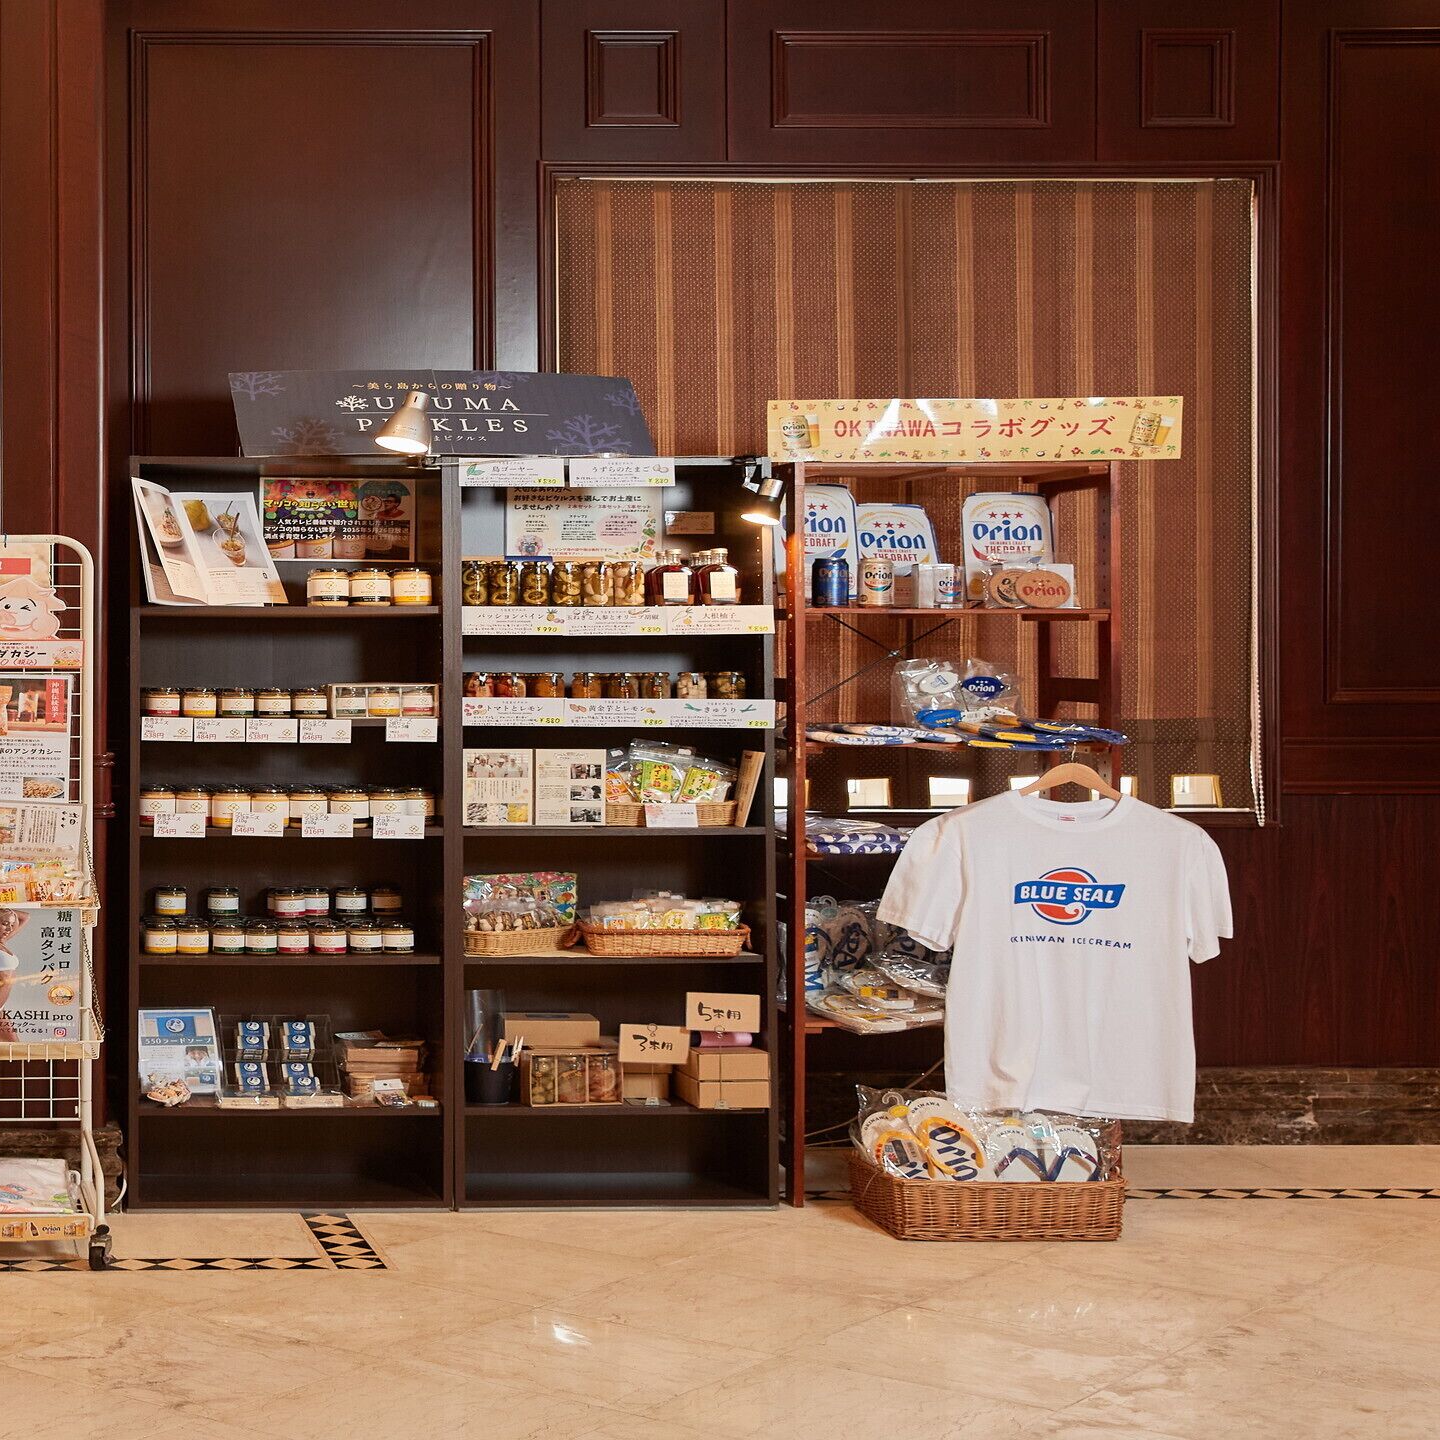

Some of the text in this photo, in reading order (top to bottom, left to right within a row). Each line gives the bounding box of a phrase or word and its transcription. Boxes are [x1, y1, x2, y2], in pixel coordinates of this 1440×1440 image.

[374, 396, 520, 411] UUMA
[356, 418, 528, 433] PKLES
[835, 415, 1116, 440] OKAWAコラボグッズ
[263, 499, 359, 509] マツコの知らない世界
[804, 511, 847, 533] rion
[972, 520, 1043, 541] Orion
[809, 538, 837, 547] DRAFT
[860, 530, 926, 549] Orion
[890, 553, 918, 562] DRAFT
[864, 570, 893, 579] Orion
[1023, 584, 1066, 597] Orion
[968, 683, 995, 692] Orion
[1020, 885, 1115, 904] BLUE SEAL
[57, 910, 72, 969] 糖質ゼロ
[1010, 935, 1132, 949] KINWAN CREAM
[40, 926, 55, 986] 高タンパク
[911, 1101, 941, 1114] OKINAWA
[929, 1126, 979, 1181] Orio
